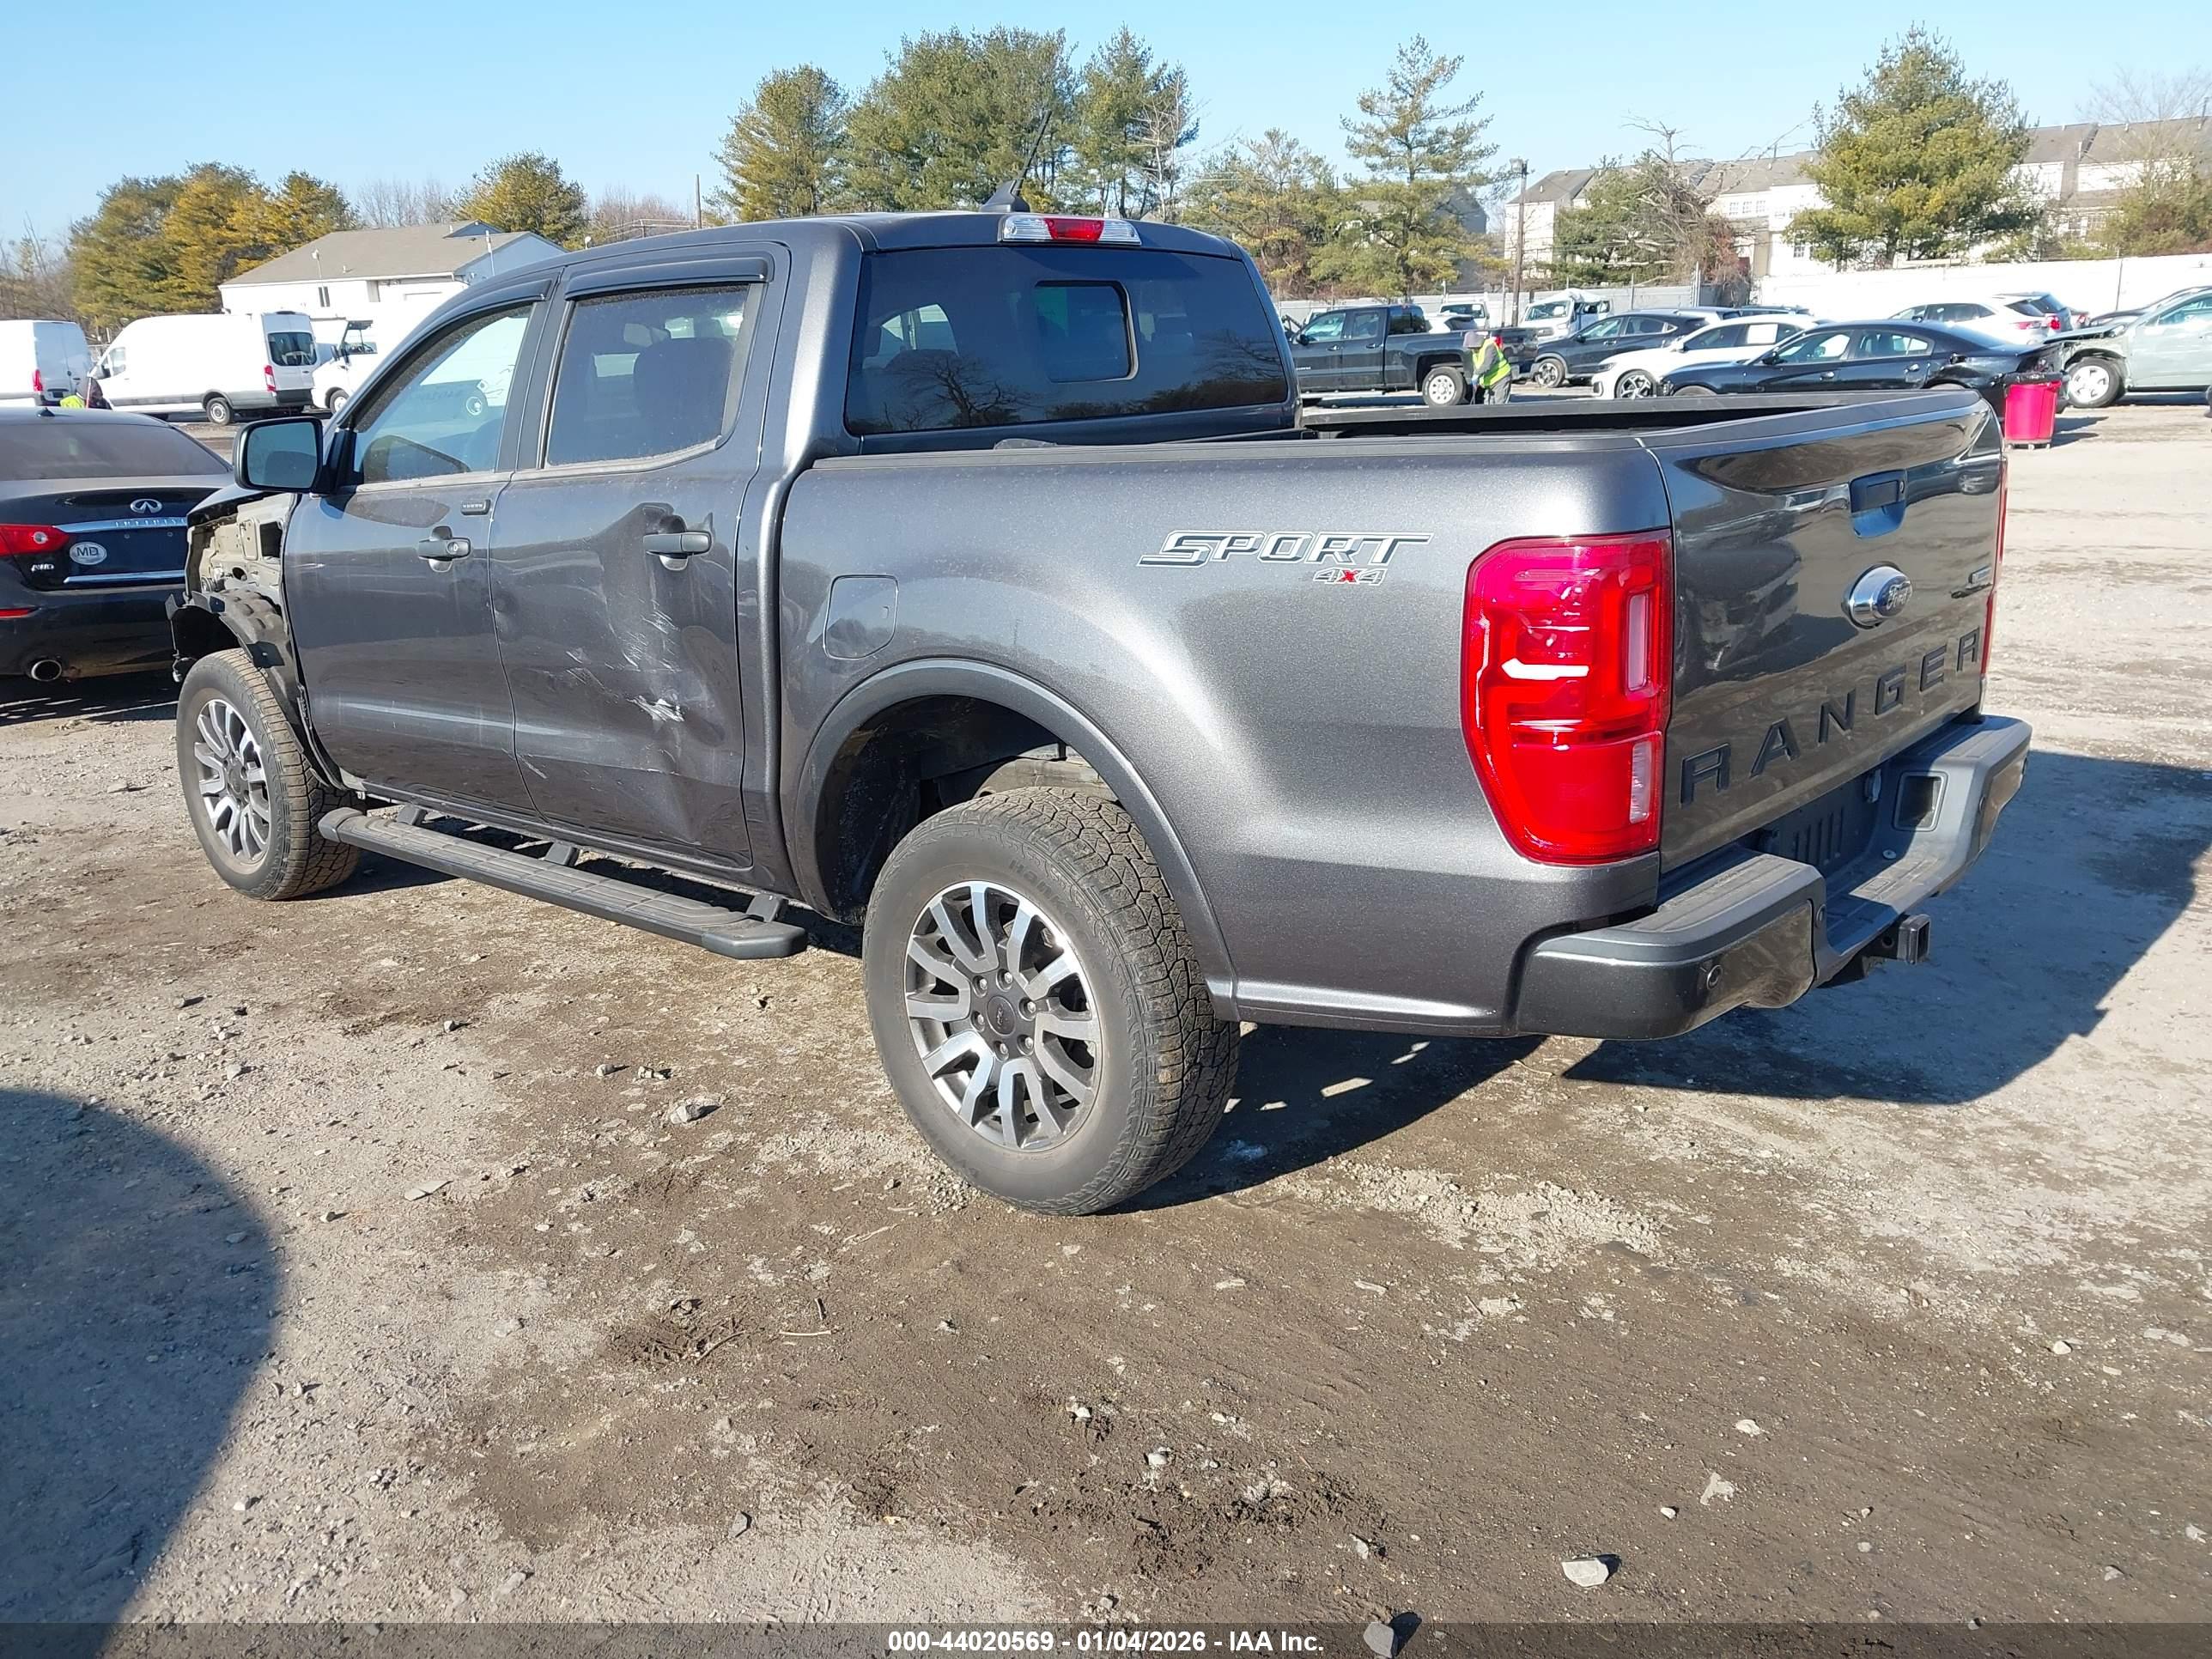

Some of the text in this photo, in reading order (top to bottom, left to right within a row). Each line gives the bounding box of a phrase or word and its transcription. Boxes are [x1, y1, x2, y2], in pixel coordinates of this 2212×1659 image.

[76, 546, 100, 557] MD
[1137, 530, 1435, 568] SPORT
[1680, 627, 1980, 809] RANGER
